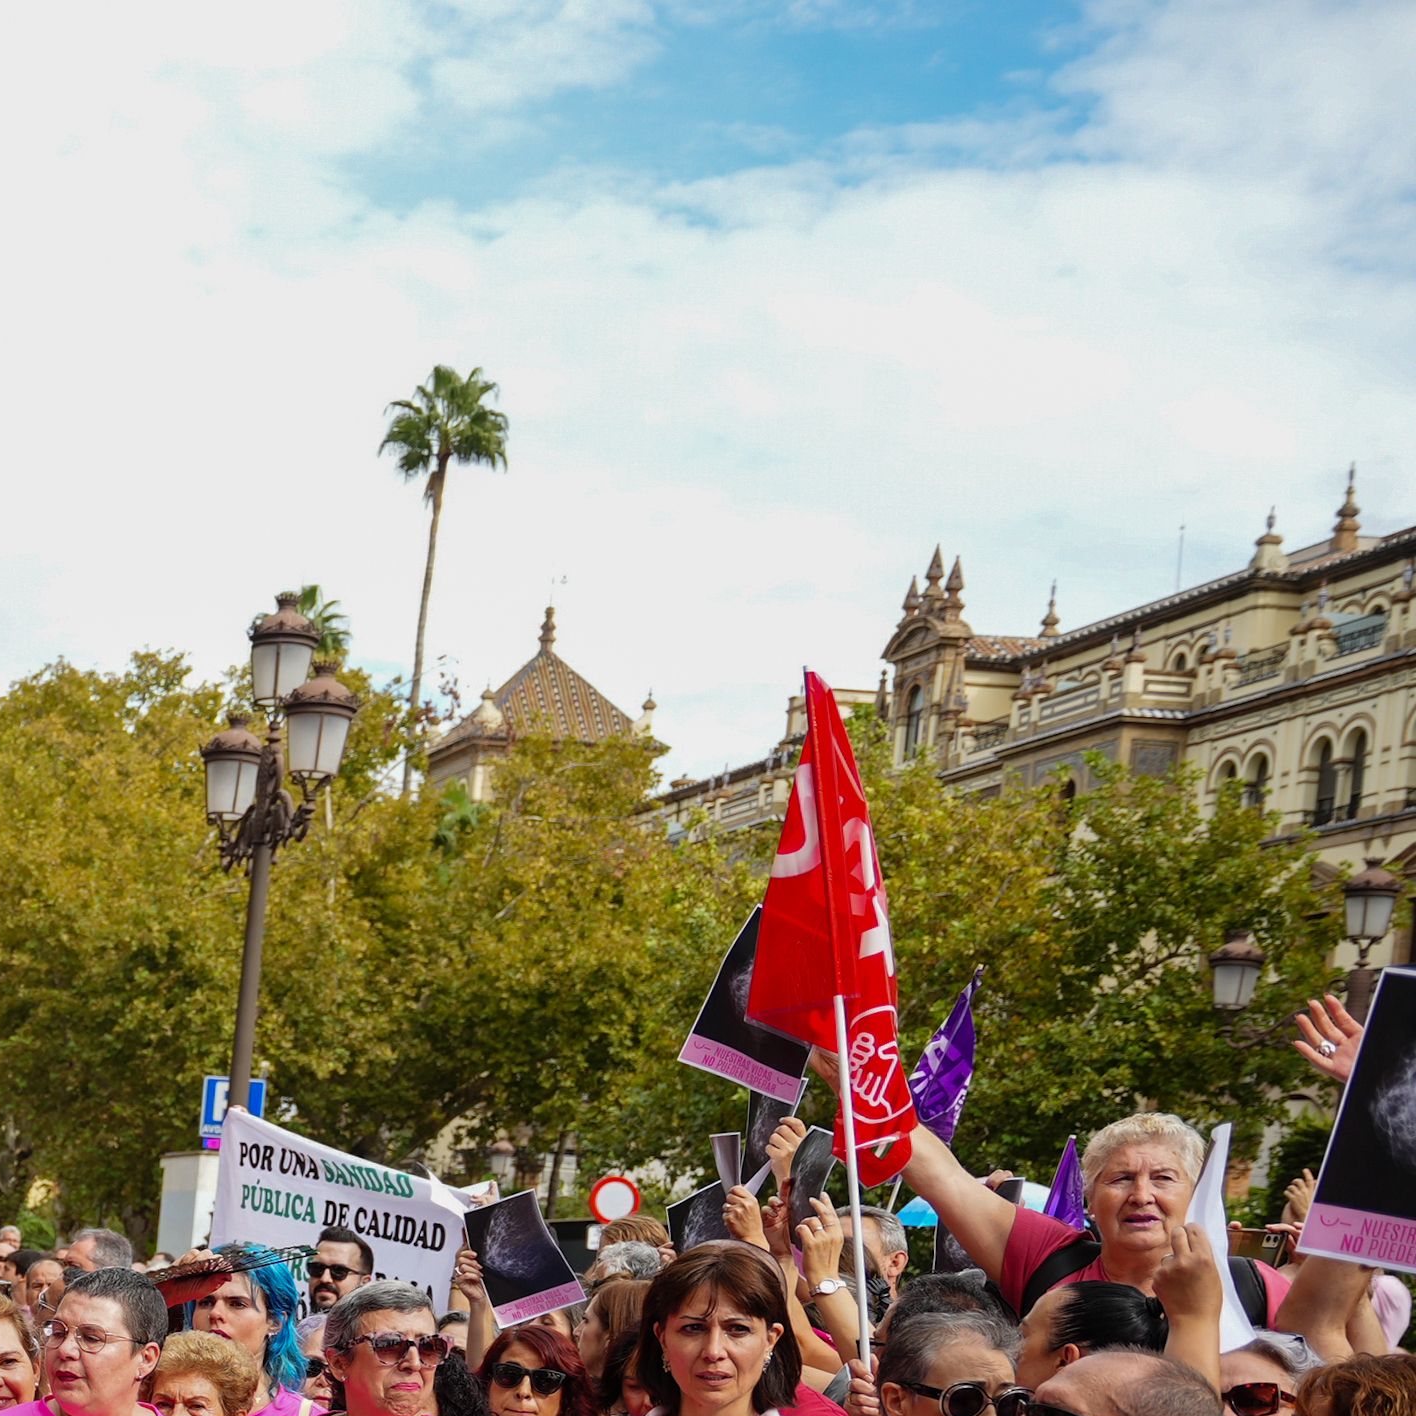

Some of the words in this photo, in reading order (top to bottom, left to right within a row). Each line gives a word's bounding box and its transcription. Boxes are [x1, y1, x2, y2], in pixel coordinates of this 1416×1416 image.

[702, 1054, 715, 1067] NO
[716, 1059, 745, 1079] PUEDEN
[715, 1047, 750, 1067] NUESTRAS
[751, 1062, 773, 1081] VIDAS
[238, 1142, 273, 1172] POR
[279, 1147, 320, 1180] UNA
[320, 1158, 415, 1199] SANIDAD
[240, 1179, 316, 1224] PÚBLICA
[323, 1200, 350, 1230] DE
[353, 1206, 446, 1252] CALIDAD
[1360, 1217, 1416, 1245] NUESTR
[1340, 1233, 1364, 1254] NO
